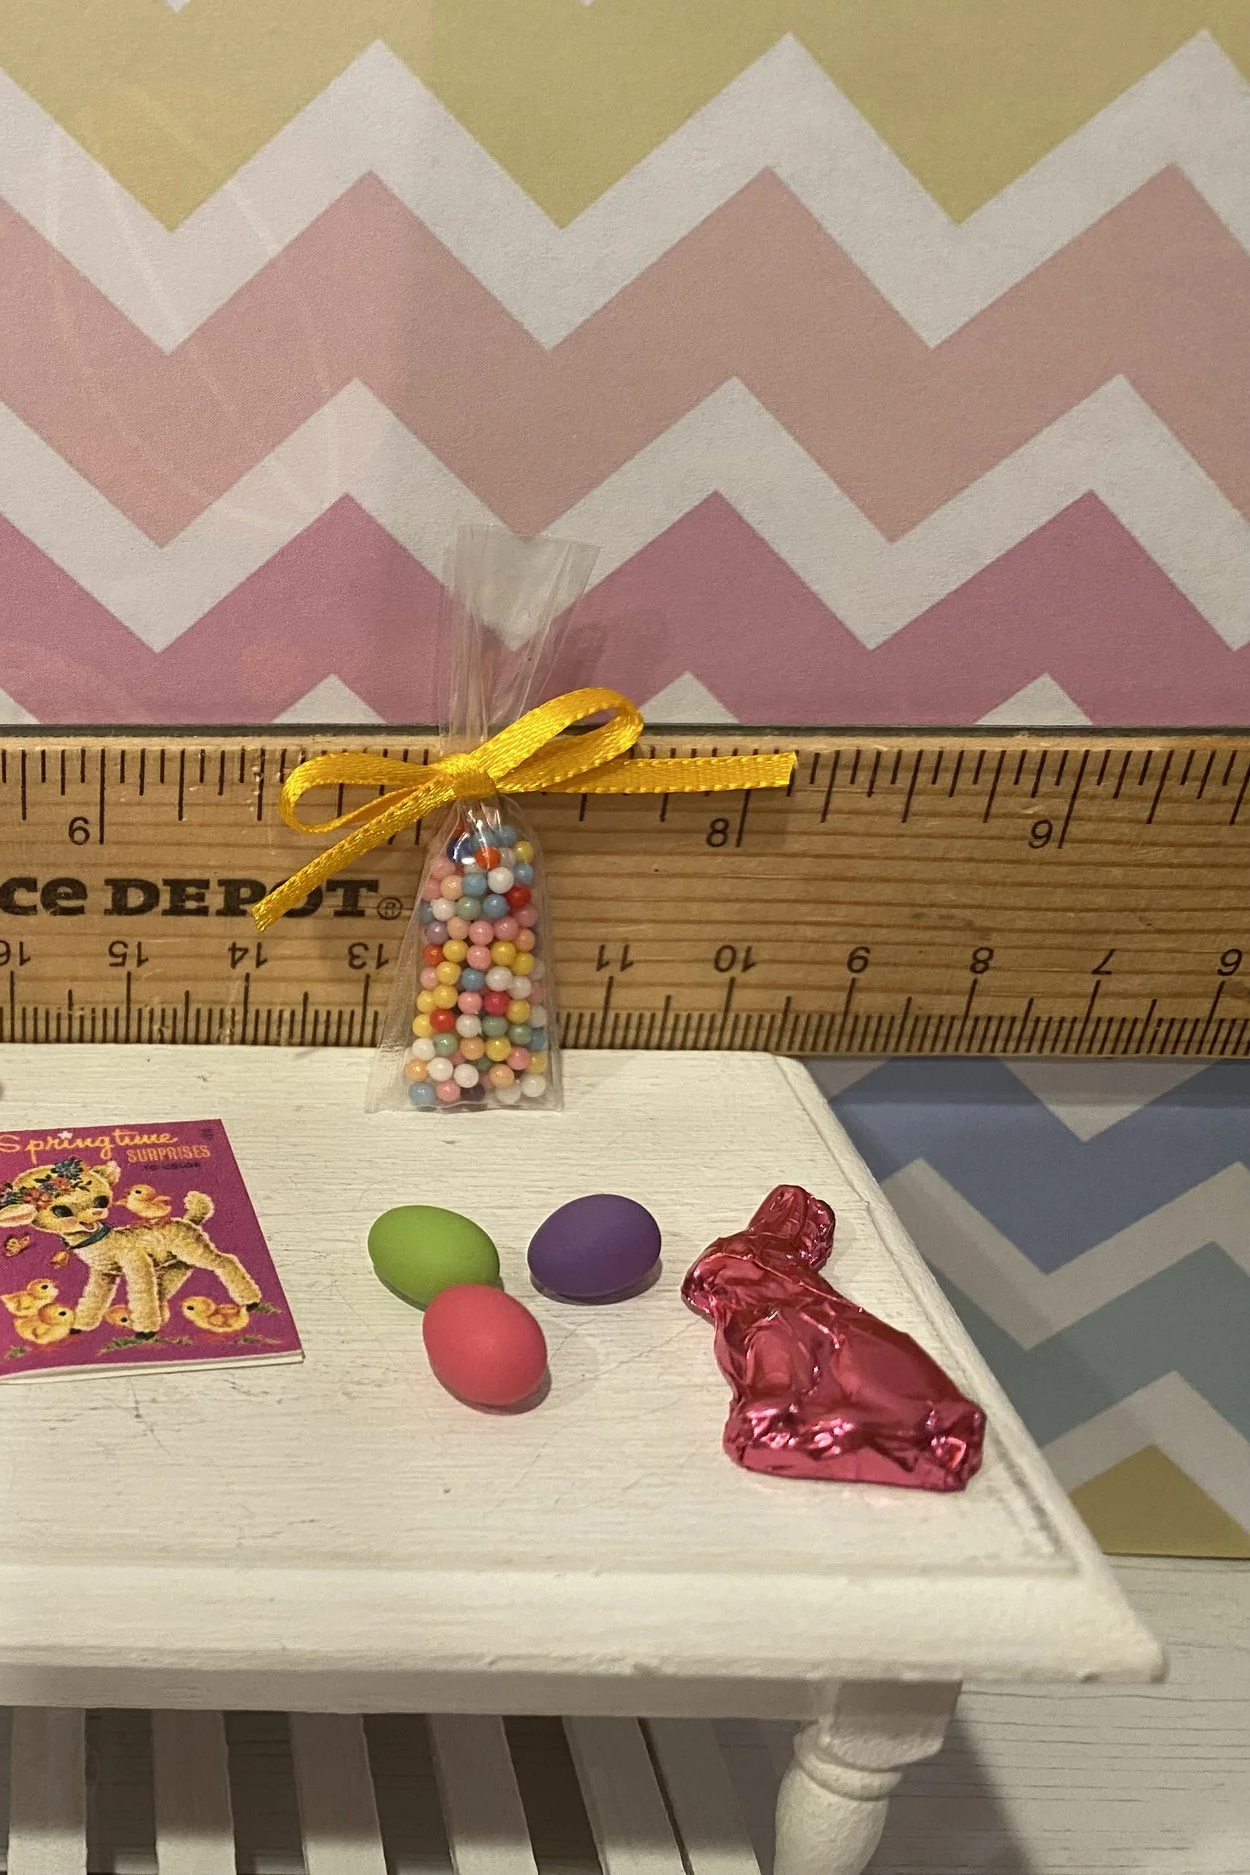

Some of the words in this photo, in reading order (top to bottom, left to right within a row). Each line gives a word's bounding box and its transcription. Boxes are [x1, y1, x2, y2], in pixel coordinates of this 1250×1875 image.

[67, 815, 91, 846] 6
[705, 817, 730, 848] 8
[1028, 818, 1054, 849] 9
[103, 877, 380, 918] DEPOT
[108, 940, 150, 968] 15
[228, 941, 269, 969] 14
[348, 942, 390, 970] 13
[595, 943, 635, 972] 11
[713, 944, 757, 973] 10
[969, 946, 994, 975] 8
[1091, 948, 1116, 976] 7
[126, 1144, 211, 1164] SURPRISES
